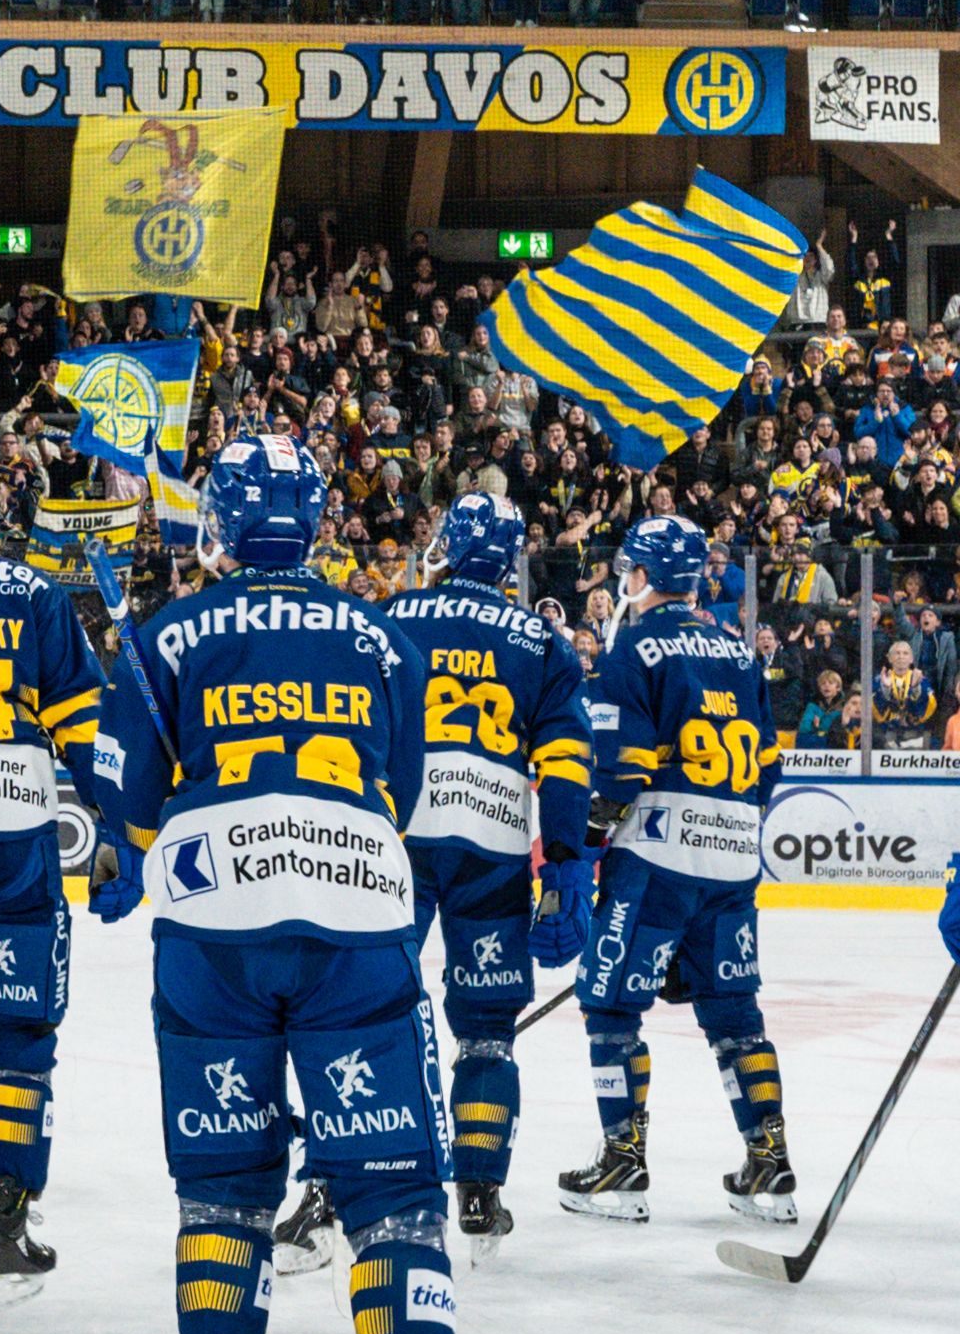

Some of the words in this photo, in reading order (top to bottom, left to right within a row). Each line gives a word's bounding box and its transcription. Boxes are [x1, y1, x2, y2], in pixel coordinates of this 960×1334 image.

[295, 47, 631, 127] DAVOS
[866, 74, 918, 96] PRO
[866, 99, 938, 123] FANS.
[62, 515, 113, 529] YOUNG
[507, 631, 546, 656] Group
[431, 649, 496, 678] FORA
[203, 681, 372, 727] KESSLER
[700, 689, 738, 717] JUNG
[680, 718, 761, 794] 90
[428, 768, 521, 803] Graubündner
[227, 815, 385, 859] Graubündner
[773, 821, 917, 875] optive
[232, 848, 407, 907] Kantonalbank
[815, 867, 862, 879] Digitale
[608, 900, 631, 942] LINK
[453, 966, 524, 987] CALANDA
[592, 959, 614, 997] BAU
[416, 999, 439, 1068] BAU
[177, 1102, 280, 1138] CALANDA
[311, 1105, 417, 1141] CALANDA
[364, 1159, 417, 1171] BAUER
